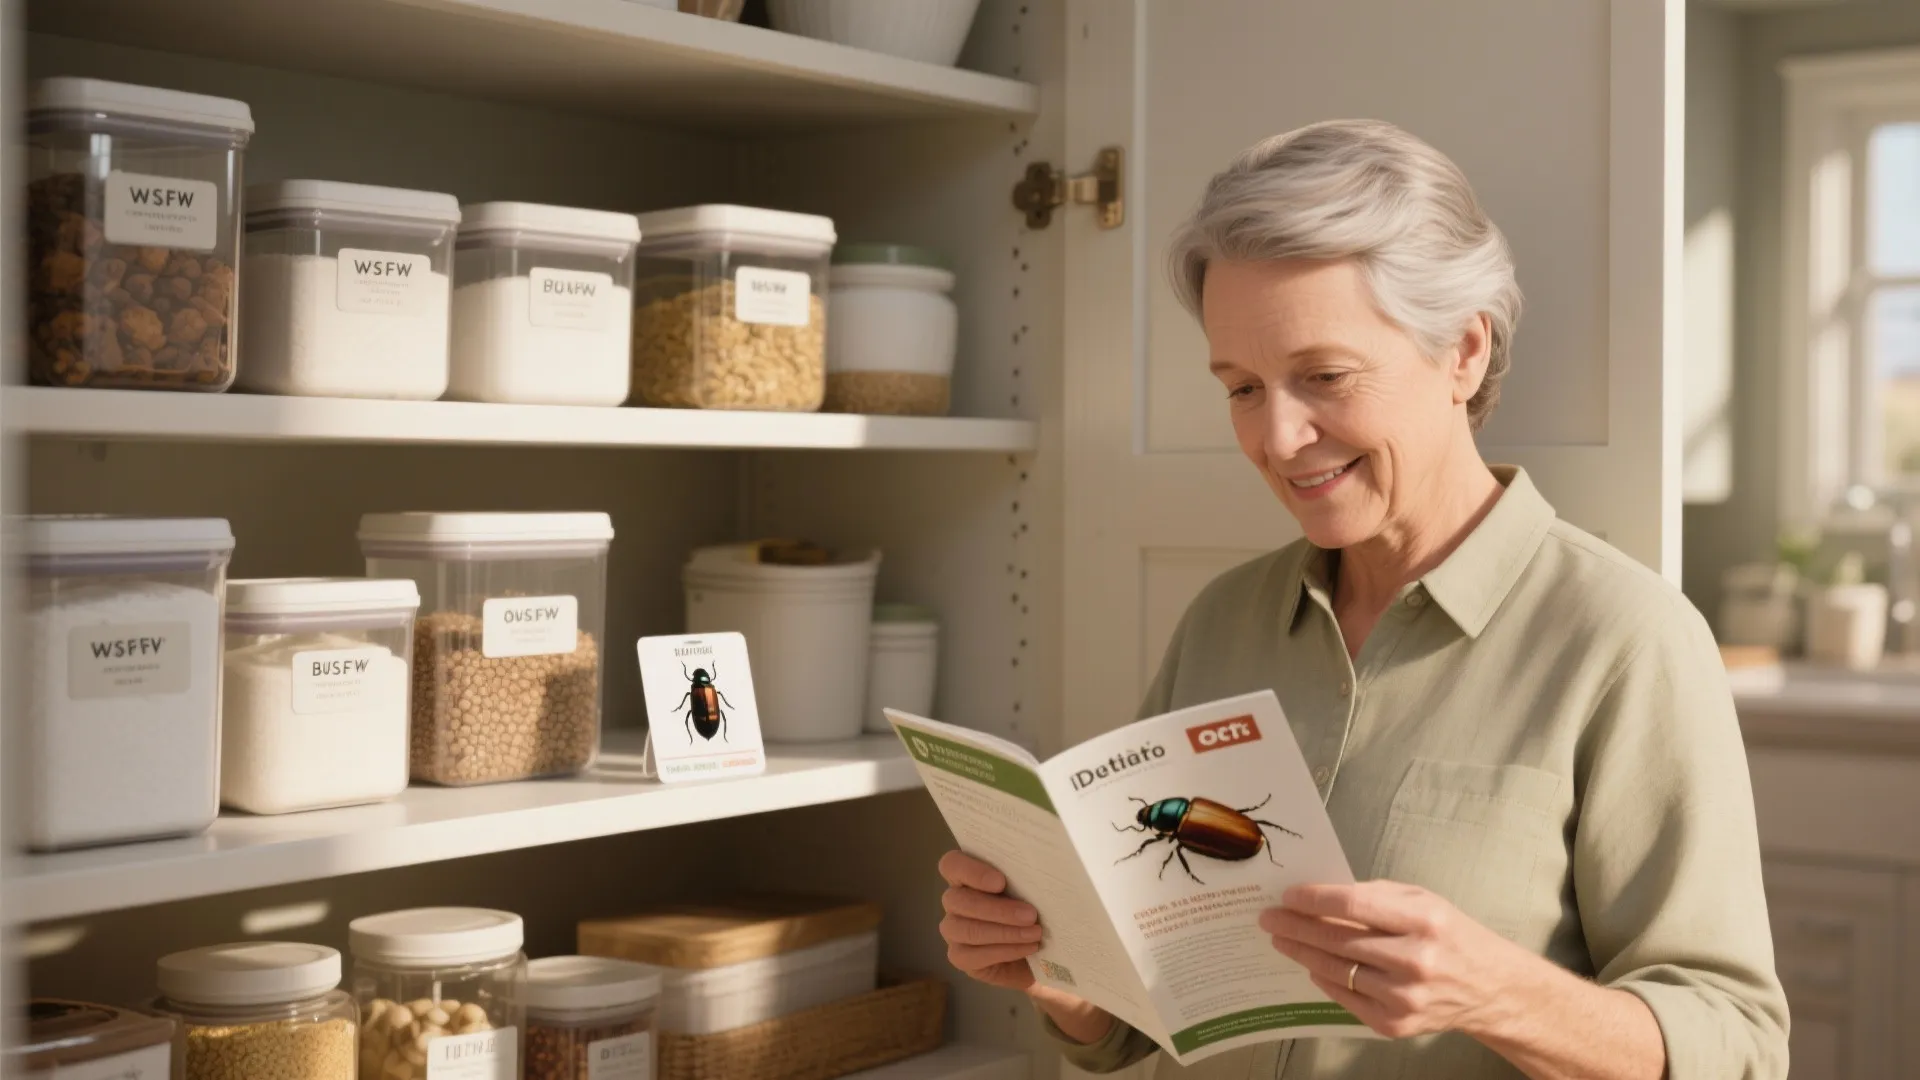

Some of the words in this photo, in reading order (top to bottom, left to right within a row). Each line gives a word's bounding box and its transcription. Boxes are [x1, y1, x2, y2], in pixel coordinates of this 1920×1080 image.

[129, 186, 195, 208] WSFW
[353, 259, 413, 278] WSFW
[311, 658, 371, 677] BUSFW
